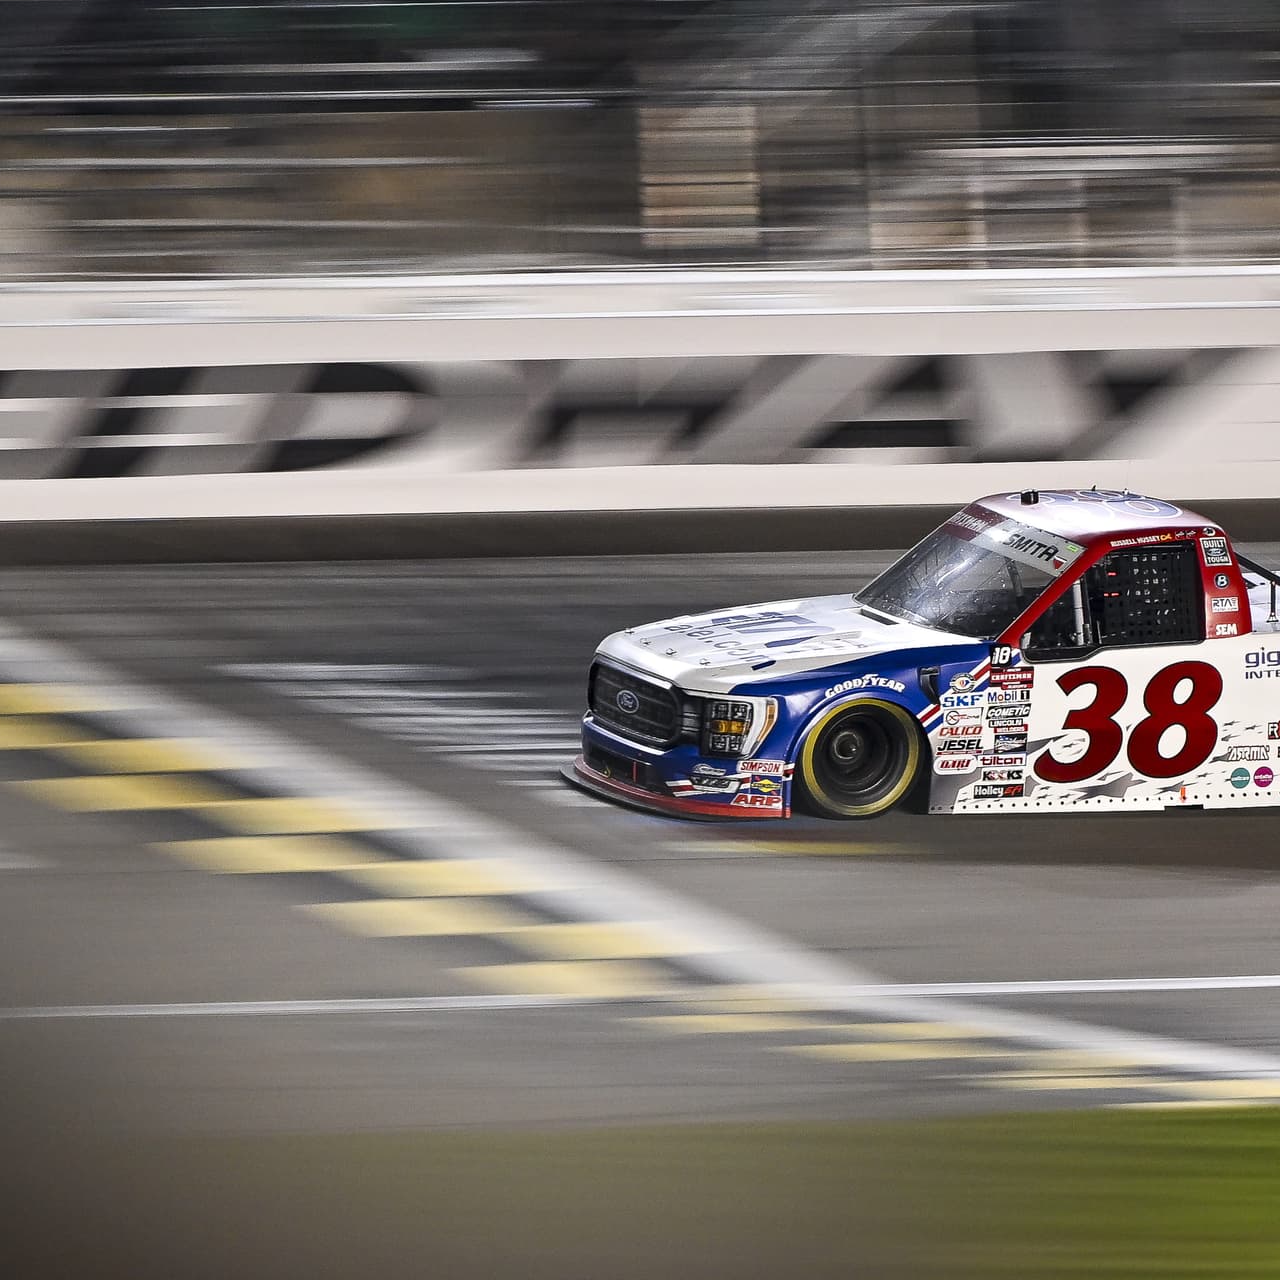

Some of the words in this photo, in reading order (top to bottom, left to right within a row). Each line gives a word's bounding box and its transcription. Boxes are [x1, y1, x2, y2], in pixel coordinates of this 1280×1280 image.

[1204, 540, 1224, 548] BUILT
[1212, 598, 1232, 607] RTA
[1216, 624, 1238, 635] SEM
[1245, 647, 1280, 668] gig
[824, 673, 905, 698] GOODYEAR
[942, 694, 983, 707] SKF
[987, 690, 1017, 702] Mobil
[987, 704, 1031, 717] COMETIC
[990, 719, 1023, 727] LINCOLN
[1033, 660, 1224, 783] 38
[939, 727, 983, 736] CALICO
[937, 739, 984, 751] JESEL
[740, 761, 780, 772] SIMPSON
[980, 757, 1023, 766] tilton
[975, 786, 1004, 797] Holley
[732, 795, 782, 806] ARP
